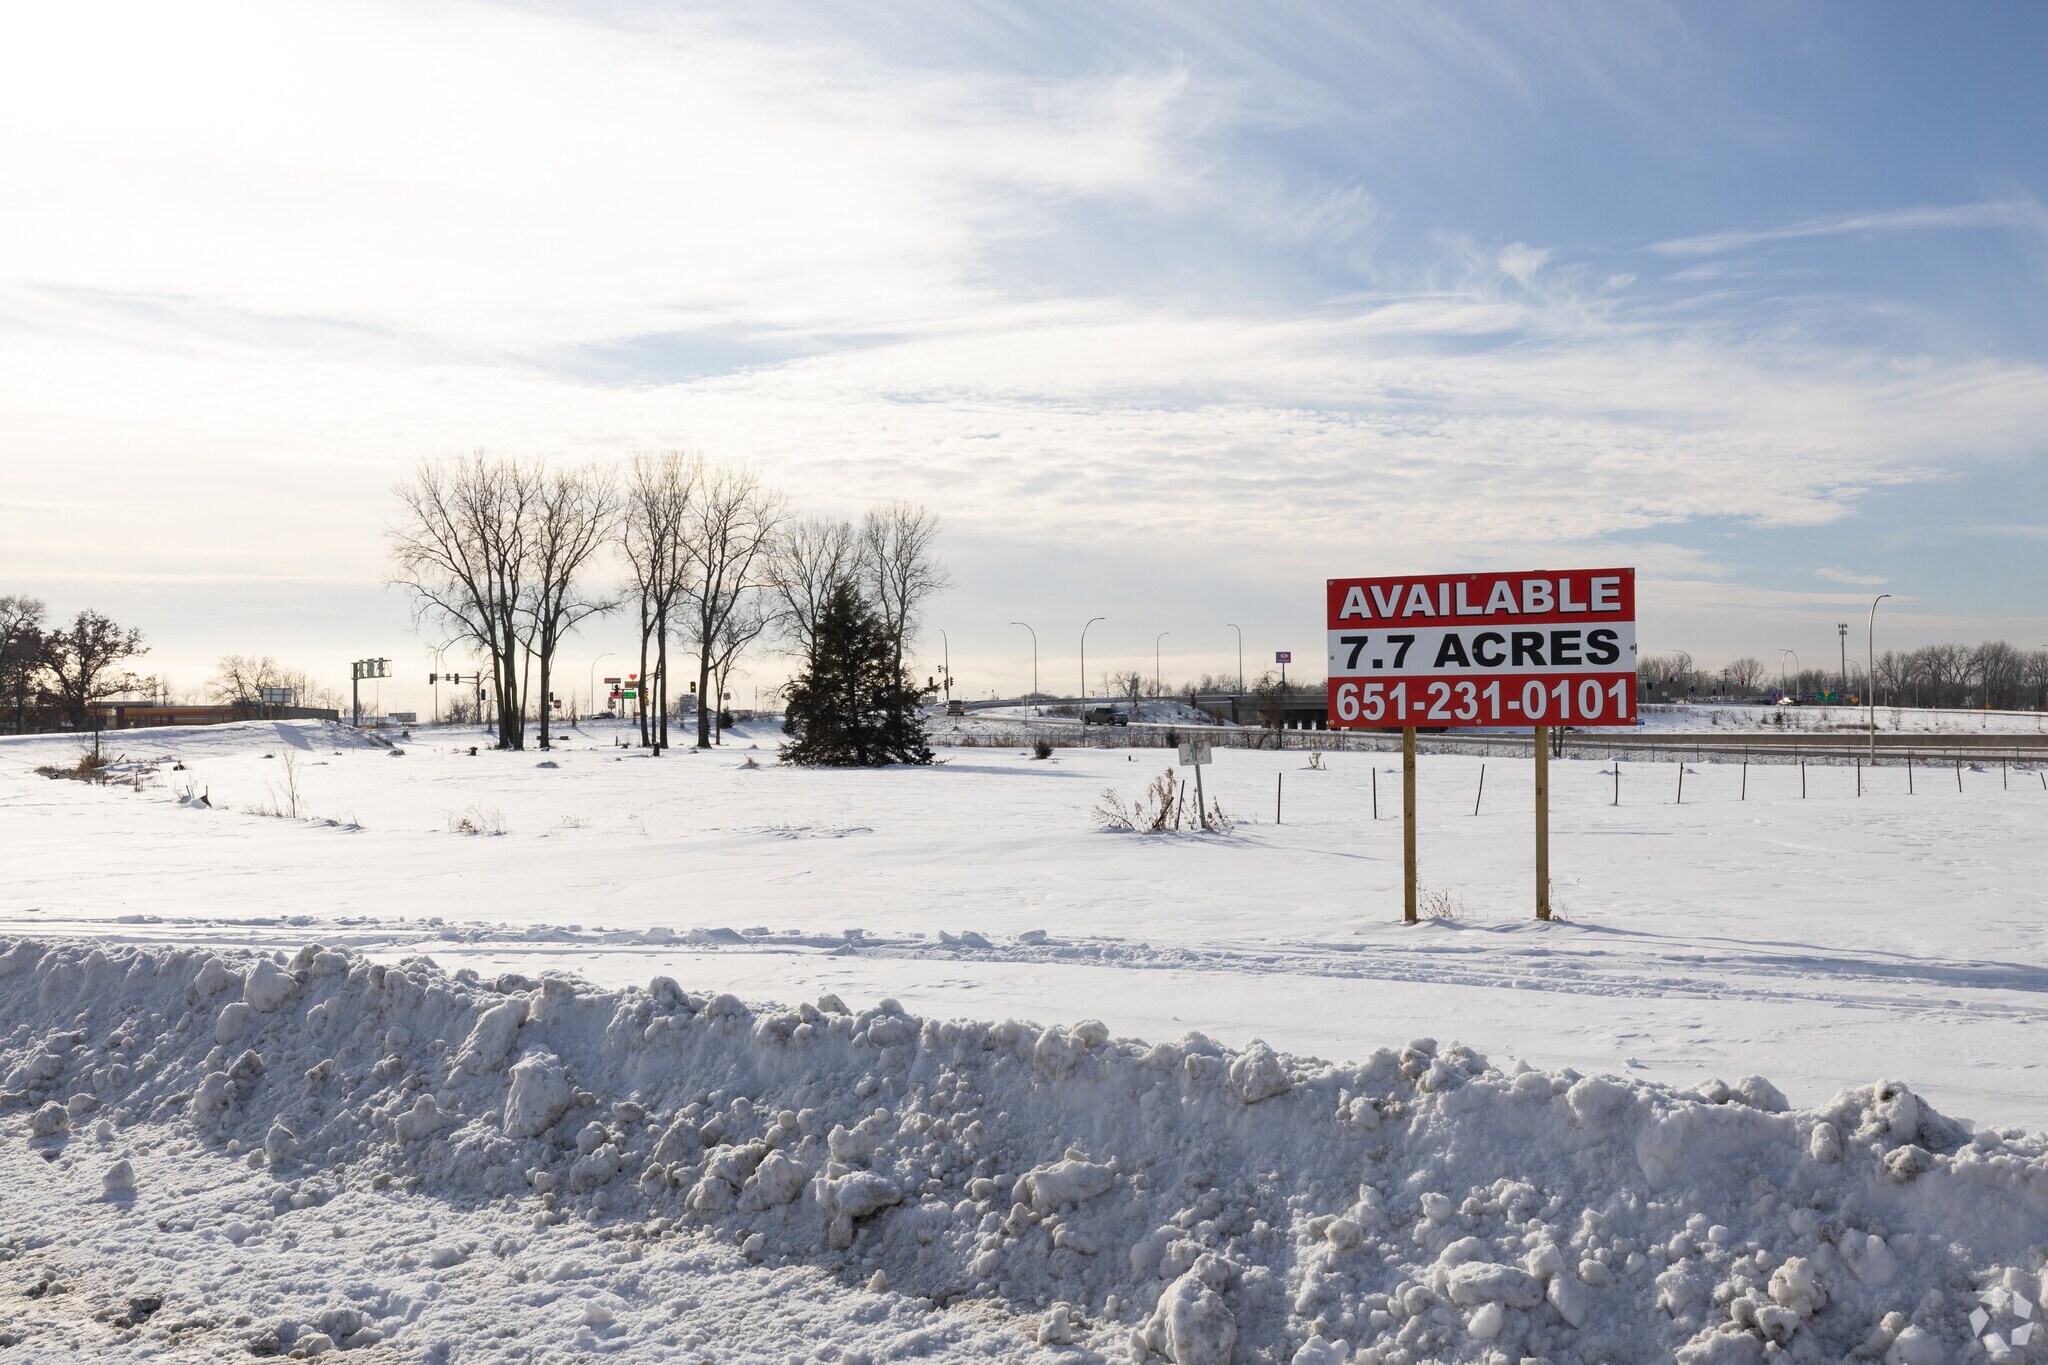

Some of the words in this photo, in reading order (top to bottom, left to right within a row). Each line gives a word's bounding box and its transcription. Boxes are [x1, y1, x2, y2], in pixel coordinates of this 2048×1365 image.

[1339, 577, 1622, 620] AVAILABLE
[1340, 635, 1416, 670] 7.7
[1433, 629, 1620, 668] ACRES
[1336, 678, 1628, 722] 651-231-0101
